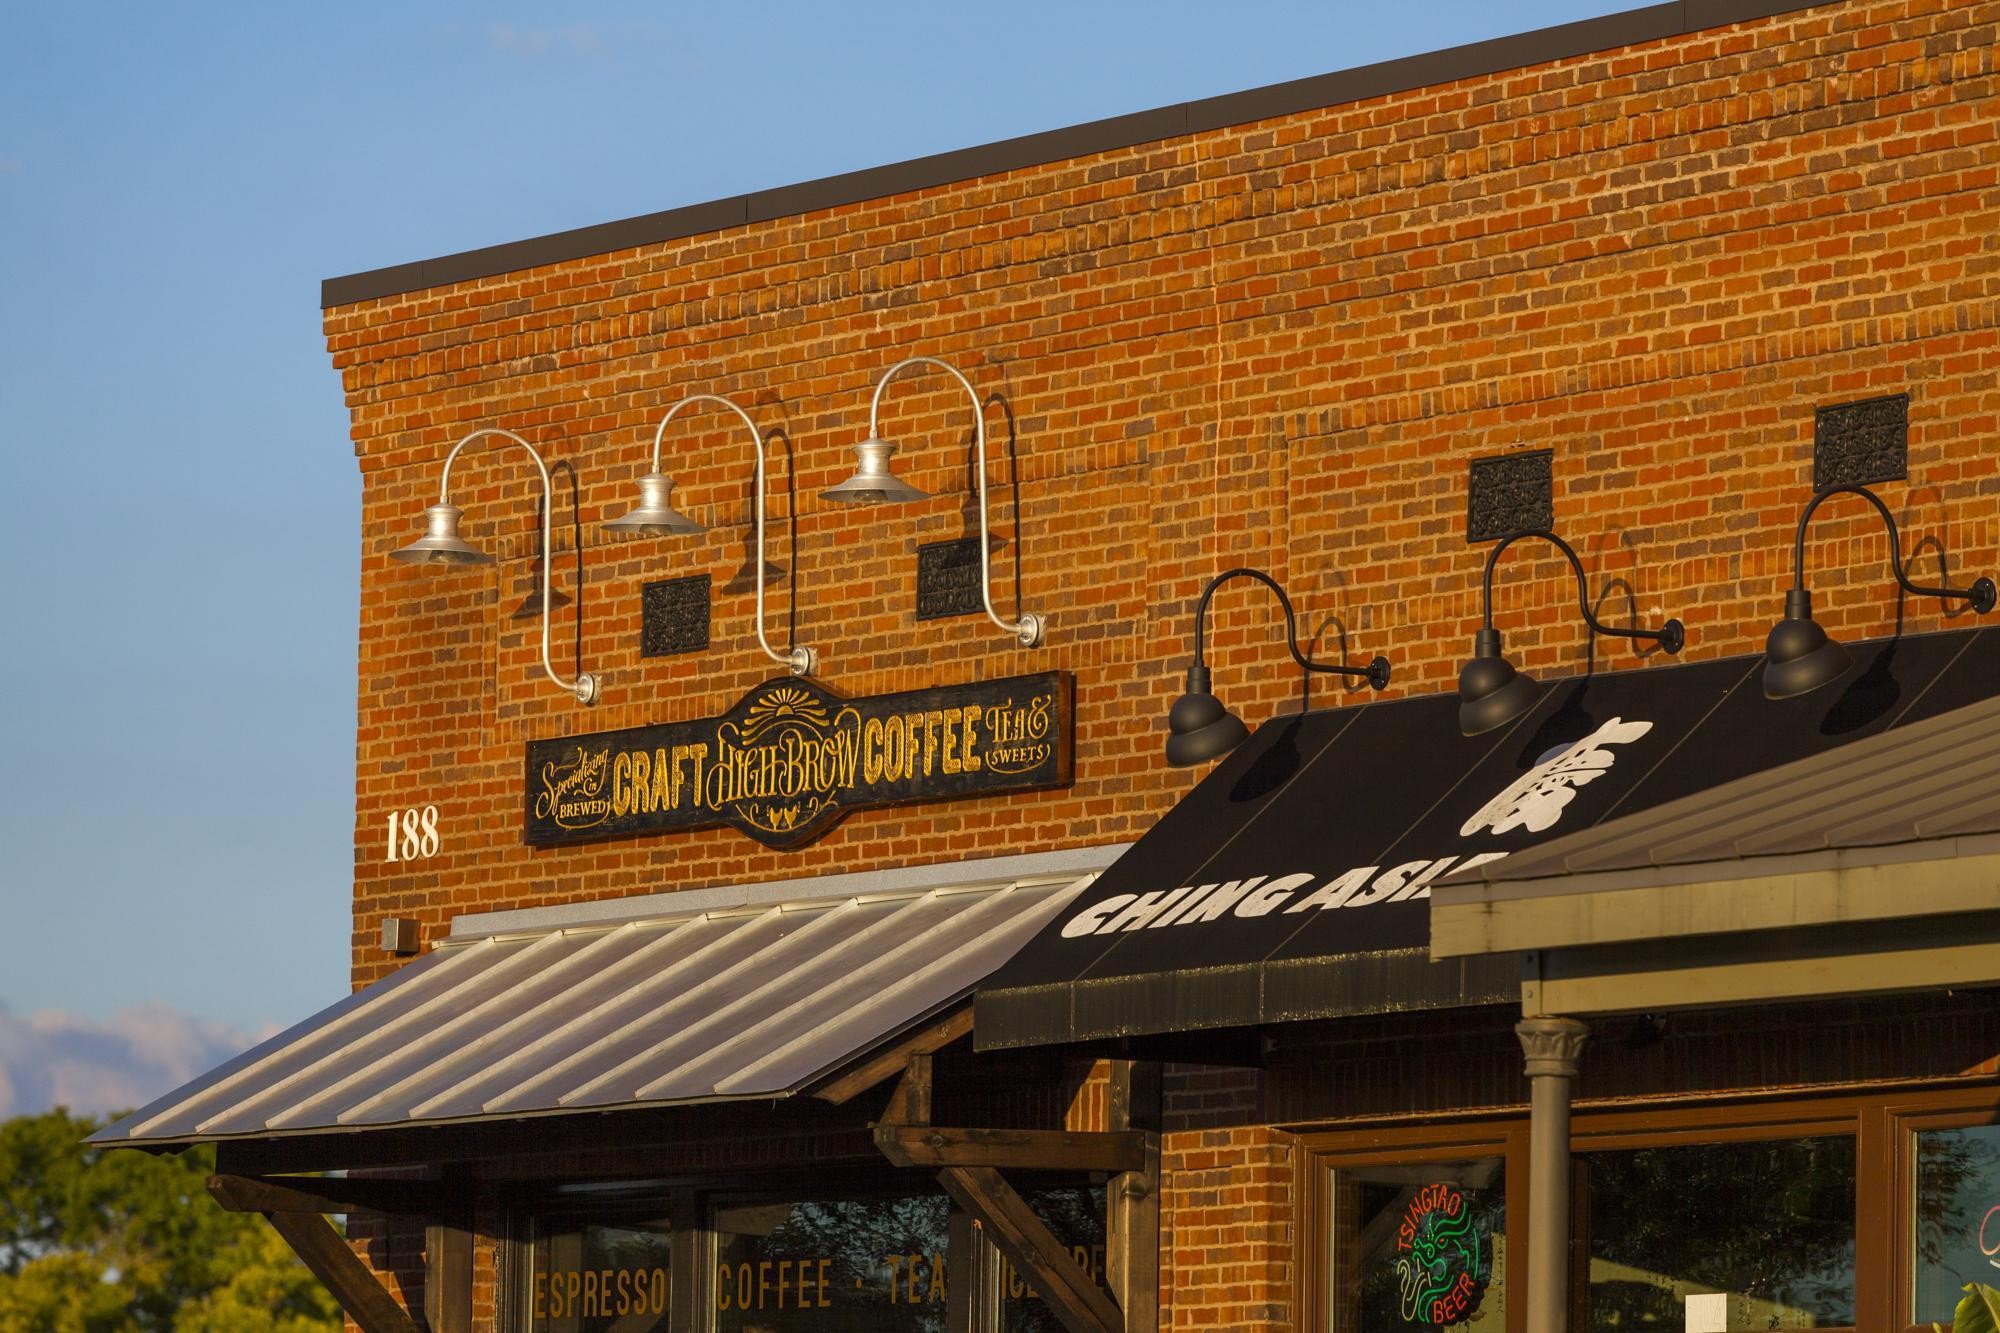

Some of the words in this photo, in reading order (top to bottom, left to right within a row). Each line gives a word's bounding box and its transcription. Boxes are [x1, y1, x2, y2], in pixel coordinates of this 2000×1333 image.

[864, 705, 982, 785] COFFEE
[992, 744, 1044, 765] SWEETS
[536, 747, 608, 819] Specializing
[560, 800, 606, 818] BREWED
[613, 743, 707, 816] CRAFT
[385, 805, 439, 863] 188
[1061, 873, 1316, 938] CHING
[1398, 1184, 1461, 1251] TSINGTAO
[534, 1268, 665, 1319] ESPRESSO
[717, 1258, 832, 1311] COFFEE
[887, 1252, 946, 1304] TEA
[1433, 1272, 1476, 1324] BEER
